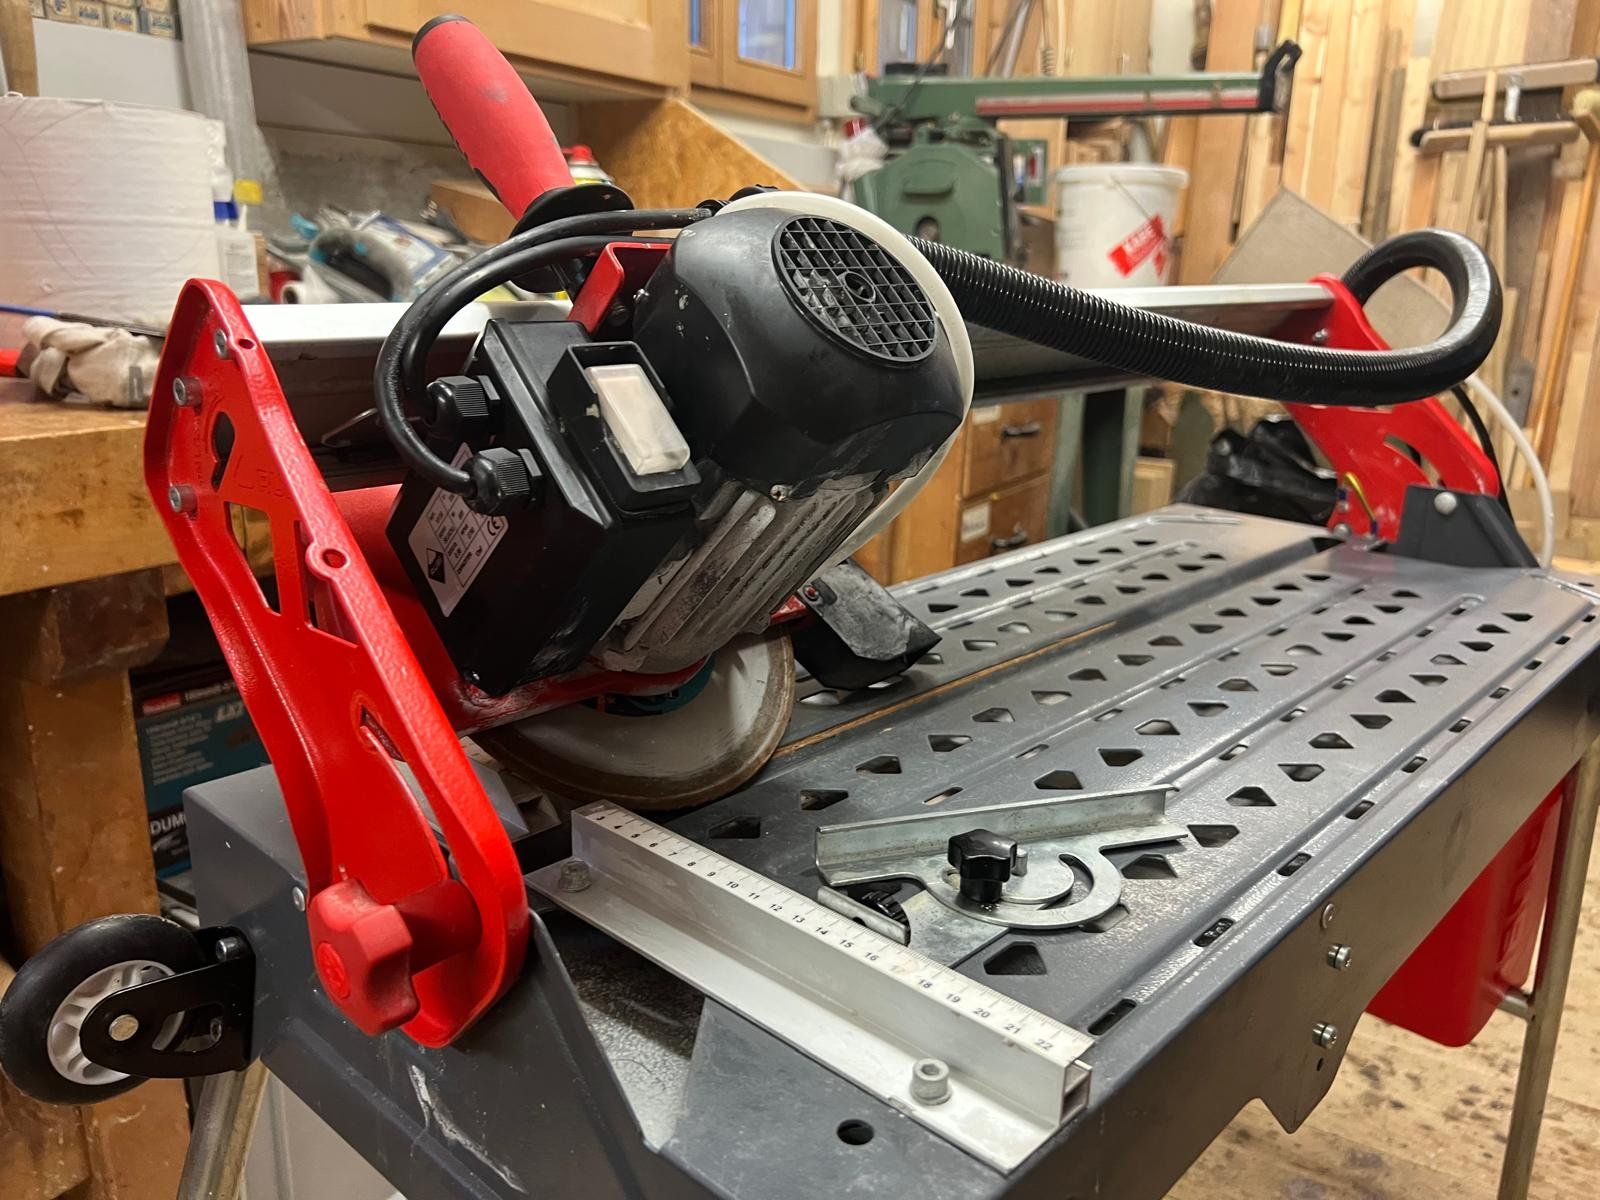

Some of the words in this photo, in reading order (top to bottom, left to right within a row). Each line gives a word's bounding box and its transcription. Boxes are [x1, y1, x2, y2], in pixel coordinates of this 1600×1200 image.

[150, 813, 187, 835] DUM
[726, 880, 740, 889] 10
[748, 892, 761, 900] 11
[769, 903, 783, 912] 12
[792, 914, 805, 924] 13
[815, 926, 828, 936] 14
[839, 938, 854, 948] 15
[864, 952, 880, 961] 16
[918, 978, 933, 989] 18
[945, 993, 961, 1003] 19
[973, 1007, 990, 1018] 20
[1004, 1023, 1021, 1035] 21
[1034, 1038, 1054, 1051] 22
